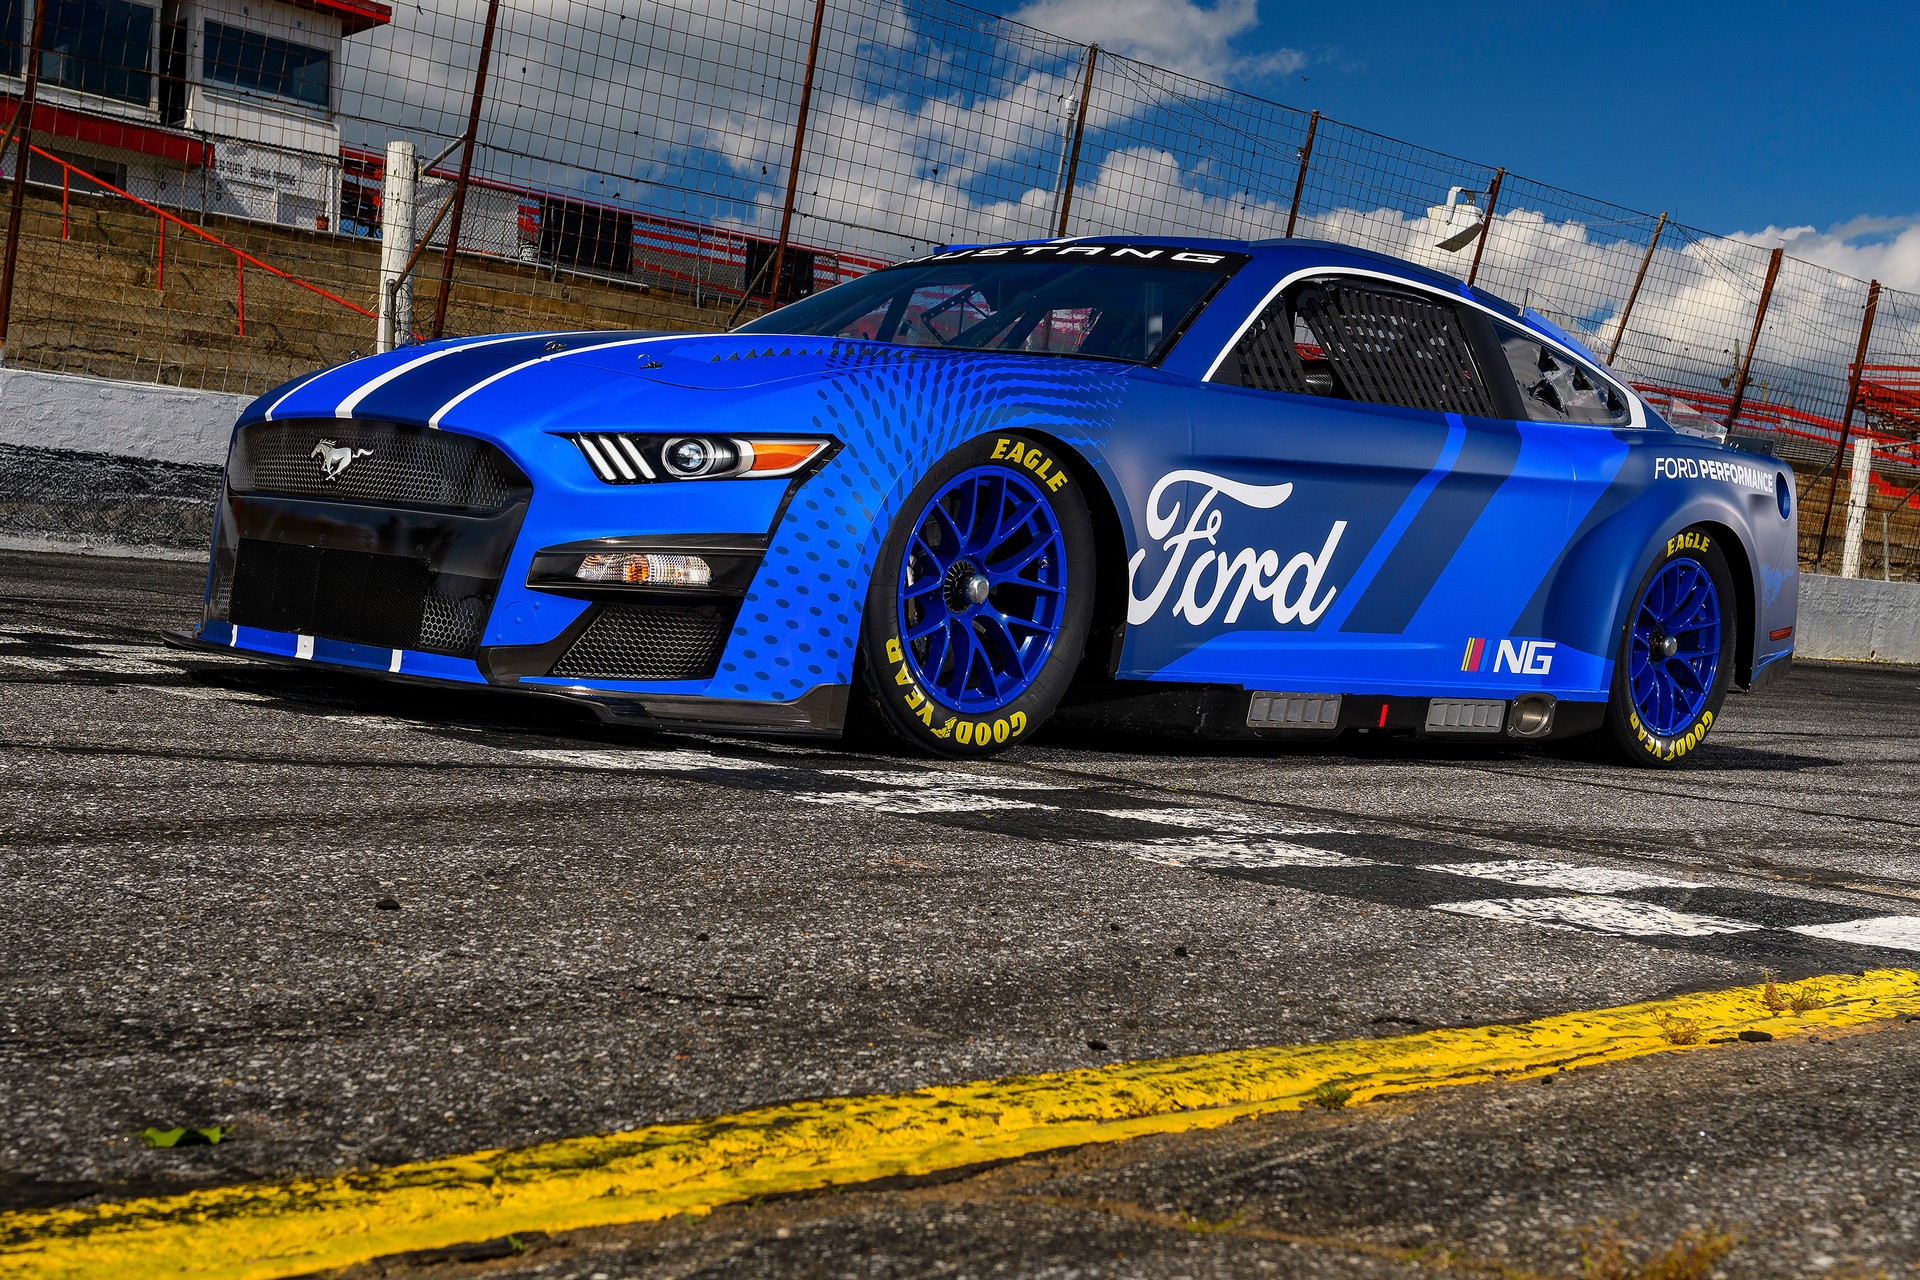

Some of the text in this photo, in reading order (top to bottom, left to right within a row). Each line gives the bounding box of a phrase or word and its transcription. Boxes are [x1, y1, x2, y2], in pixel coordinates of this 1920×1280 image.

[990, 438, 1069, 493] EAGLE
[1654, 457, 1774, 494] FORD PERFORMANCE
[1127, 469, 1348, 626] Ford
[1666, 532, 1711, 558] EAGLE
[1493, 639, 1557, 675] NG
